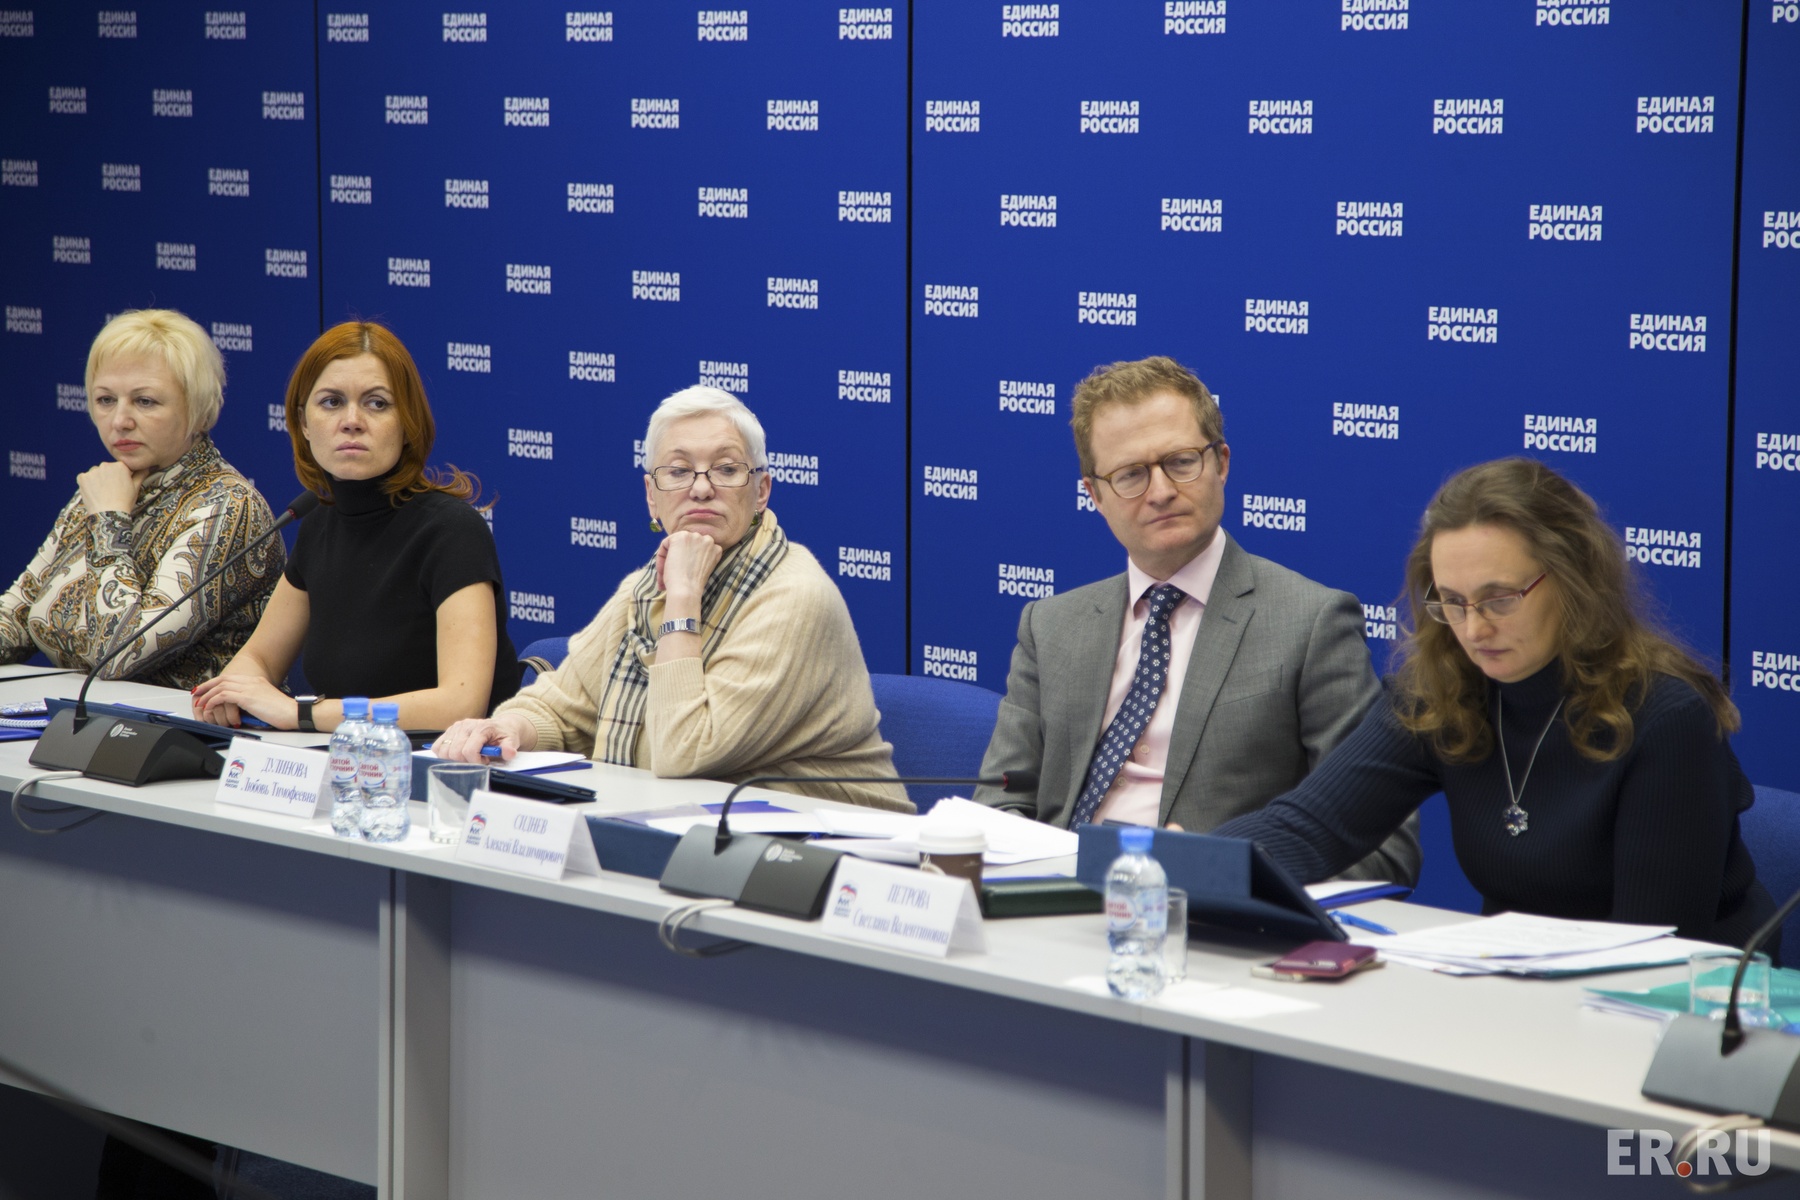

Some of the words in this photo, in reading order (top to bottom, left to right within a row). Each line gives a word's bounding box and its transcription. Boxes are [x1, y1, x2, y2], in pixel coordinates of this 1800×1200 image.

[1003, 4, 1059, 21] ЕДИНАЯ
[1165, 0, 1226, 18] ЕДИНАЯ
[1342, 0, 1408, 13] ЕДИНАЯ
[99, 11, 136, 24] ЕДИНАЯ
[206, 12, 246, 26] ЕДИНАЯ
[328, 14, 368, 28] ЕДИНАЯ
[443, 13, 486, 28] ЕДИНАЯ
[566, 12, 612, 26] ЕДИНАЯ
[698, 11, 747, 26] ЕДИНАЯ
[839, 8, 892, 24] ЕДИНАЯ
[1342, 13, 1408, 31] РОССИЯ
[1536, 7, 1609, 26] РОССИЯ
[99, 24, 137, 38] РОССИЯ
[206, 26, 246, 39] РОССИЯ
[567, 26, 612, 41] РОССИЯ
[698, 26, 747, 41] РОССИЯ
[839, 25, 892, 39] РОССИЯ
[1003, 21, 1058, 37] РОССИЯ
[1165, 18, 1225, 34] РОССИЯ
[328, 28, 369, 42] РОССИЯ
[443, 28, 487, 42] РОССИЯ
[50, 87, 86, 100] ЕДИНАЯ
[153, 90, 192, 103] ЕДИНАЯ
[263, 92, 304, 106] ЕДИНАЯ
[50, 99, 86, 113] РОССИЯ
[154, 103, 192, 116] РОССИЯ
[386, 96, 428, 109] ЕДИНАЯ
[505, 97, 549, 111] ЕДИНАЯ
[632, 99, 679, 114] ЕДИНАЯ
[767, 100, 818, 115] ЕДИНАЯ
[926, 101, 979, 116] ЕДИНАЯ
[1081, 101, 1139, 117] ЕДИНАЯ
[1249, 100, 1312, 117] ЕДИНАЯ
[1434, 99, 1503, 117] ЕДИНАЯ
[1637, 96, 1714, 115] ЕДИНАЯ
[263, 106, 304, 120] РОССИЯ
[386, 109, 428, 124] РОССИЯ
[505, 111, 549, 126] РОССИЯ
[632, 114, 679, 128] РОССИЯ
[767, 115, 818, 130] РОССИЯ
[926, 117, 979, 132] РОССИЯ
[1081, 118, 1139, 133] РОССИЯ
[1249, 118, 1312, 134] РОССИЯ
[1433, 117, 1502, 134] РОССИЯ
[1637, 116, 1713, 133] РОССИЯ
[2, 160, 38, 173] ЕДИНАЯ
[103, 164, 140, 177] ЕДИНАЯ
[2, 172, 38, 186] РОССИЯ
[209, 168, 249, 182] ЕДИНАЯ
[331, 175, 371, 189] ЕДИНАЯ
[103, 177, 141, 191] РОССИЯ
[209, 182, 249, 196] РОССИЯ
[445, 179, 488, 193] ЕДИНАЯ
[568, 183, 613, 197] ЕДИНАЯ
[331, 189, 371, 204] РОССИЯ
[446, 193, 489, 208] РОССИЯ
[699, 187, 747, 202] ЕДИНАЯ
[839, 191, 891, 206] ЕДИНАЯ
[1001, 195, 1056, 210] ЕДИНАЯ
[568, 197, 613, 213] РОССИЯ
[699, 202, 747, 218] РОССИЯ
[1162, 199, 1222, 214] ЕДИНАЯ
[1337, 202, 1403, 218] ЕДИНАЯ
[839, 207, 891, 222] РОССИЯ
[1001, 211, 1056, 227] РОССИЯ
[1530, 205, 1602, 222] ЕДИНАЯ
[1162, 215, 1221, 232] РОССИЯ
[1337, 219, 1402, 236] РОССИЯ
[1529, 223, 1601, 241] РОССИЯ
[54, 236, 90, 250] ЕДИНАЯ
[157, 243, 196, 257] ЕДИНАЯ
[54, 249, 90, 263] РОССИЯ
[157, 255, 196, 271] РОССИЯ
[266, 249, 307, 263] ЕДИНАЯ
[266, 262, 307, 277] РОССИЯ
[389, 258, 430, 272] ЕДИНАЯ
[507, 264, 551, 279] ЕДИНАЯ
[389, 272, 430, 287] РОССИЯ
[507, 278, 551, 294] РОССИЯ
[633, 271, 680, 285] ЕДИНАЯ
[768, 278, 818, 293] ЕДИНАЯ
[633, 285, 680, 301] РОССИЯ
[768, 292, 818, 309] РОССИЯ
[925, 285, 978, 300] ЕДИНАЯ
[1079, 292, 1136, 308] ЕДИНАЯ
[6, 306, 42, 320] ЕДИНАЯ
[925, 300, 978, 317] РОССИЯ
[1246, 299, 1308, 316] ЕДИНАЯ
[1429, 307, 1497, 324] ЕДИНАЯ
[1079, 308, 1136, 325] РОССИЯ
[1630, 314, 1706, 332] ЕДИНАЯ
[7, 319, 42, 333] РОССИЯ
[212, 322, 252, 337] ЕДИНАЯ
[1246, 316, 1308, 334] РОССИЯ
[1428, 324, 1497, 343] РОССИЯ
[448, 342, 490, 358] ЕДИНАЯ
[1630, 333, 1705, 352] РОССИЯ
[448, 357, 490, 372] РОССИЯ
[569, 351, 615, 367] ЕДИНАЯ
[570, 366, 615, 382] РОССИЯ
[699, 361, 748, 377] ЕДИНАЯ
[839, 370, 890, 386] ЕДИНАЯ
[839, 385, 890, 403] РОССИЯ
[1000, 381, 1055, 397] ЕДИНАЯ
[1000, 396, 1054, 414] РОССИЯ
[1333, 402, 1398, 421] ЕДИНАЯ
[1333, 420, 1398, 439] РОССИЯ
[1525, 415, 1596, 434] ЕДИНАЯ
[509, 429, 552, 444] ЕДИНАЯ
[1524, 433, 1596, 453] РОССИЯ
[10, 451, 46, 467] ЕДИНАЯ
[509, 443, 552, 459] РОССИЯ
[768, 451, 818, 469] ЕДИНАЯ
[10, 464, 46, 480] РОССИЯ
[768, 467, 818, 486] РОССИЯ
[925, 466, 977, 483] ЕДИНАЯ
[925, 481, 977, 500] РОССИЯ
[1243, 494, 1305, 513] ЕДИНАЯ
[571, 517, 616, 534] ЕДИНАЯ
[1243, 511, 1305, 531] РОССИЯ
[571, 531, 616, 549] РОССИЯ
[1626, 527, 1701, 548] ЕДИНАЯ
[839, 547, 890, 565] ЕДИНАЯ
[1625, 546, 1700, 568] РОССИЯ
[839, 562, 890, 581] РОССИЯ
[999, 563, 1054, 583] ЕДИНАЯ
[999, 579, 1054, 599] РОССИЯ
[511, 591, 554, 608] ЕДИНАЯ
[511, 605, 554, 623] РОССИЯ
[924, 645, 977, 664] ЕДИНАЯ
[924, 661, 976, 681] РОССИЯ
[240, 777, 270, 796] Любовь
[271, 782, 317, 804] Тимофеевна
[484, 835, 512, 854] Алексей
[511, 839, 565, 866] Владимирович
[887, 883, 932, 909] ПЕТРОВА
[852, 907, 890, 933] Светлана
[890, 914, 950, 945] Валентиновна
